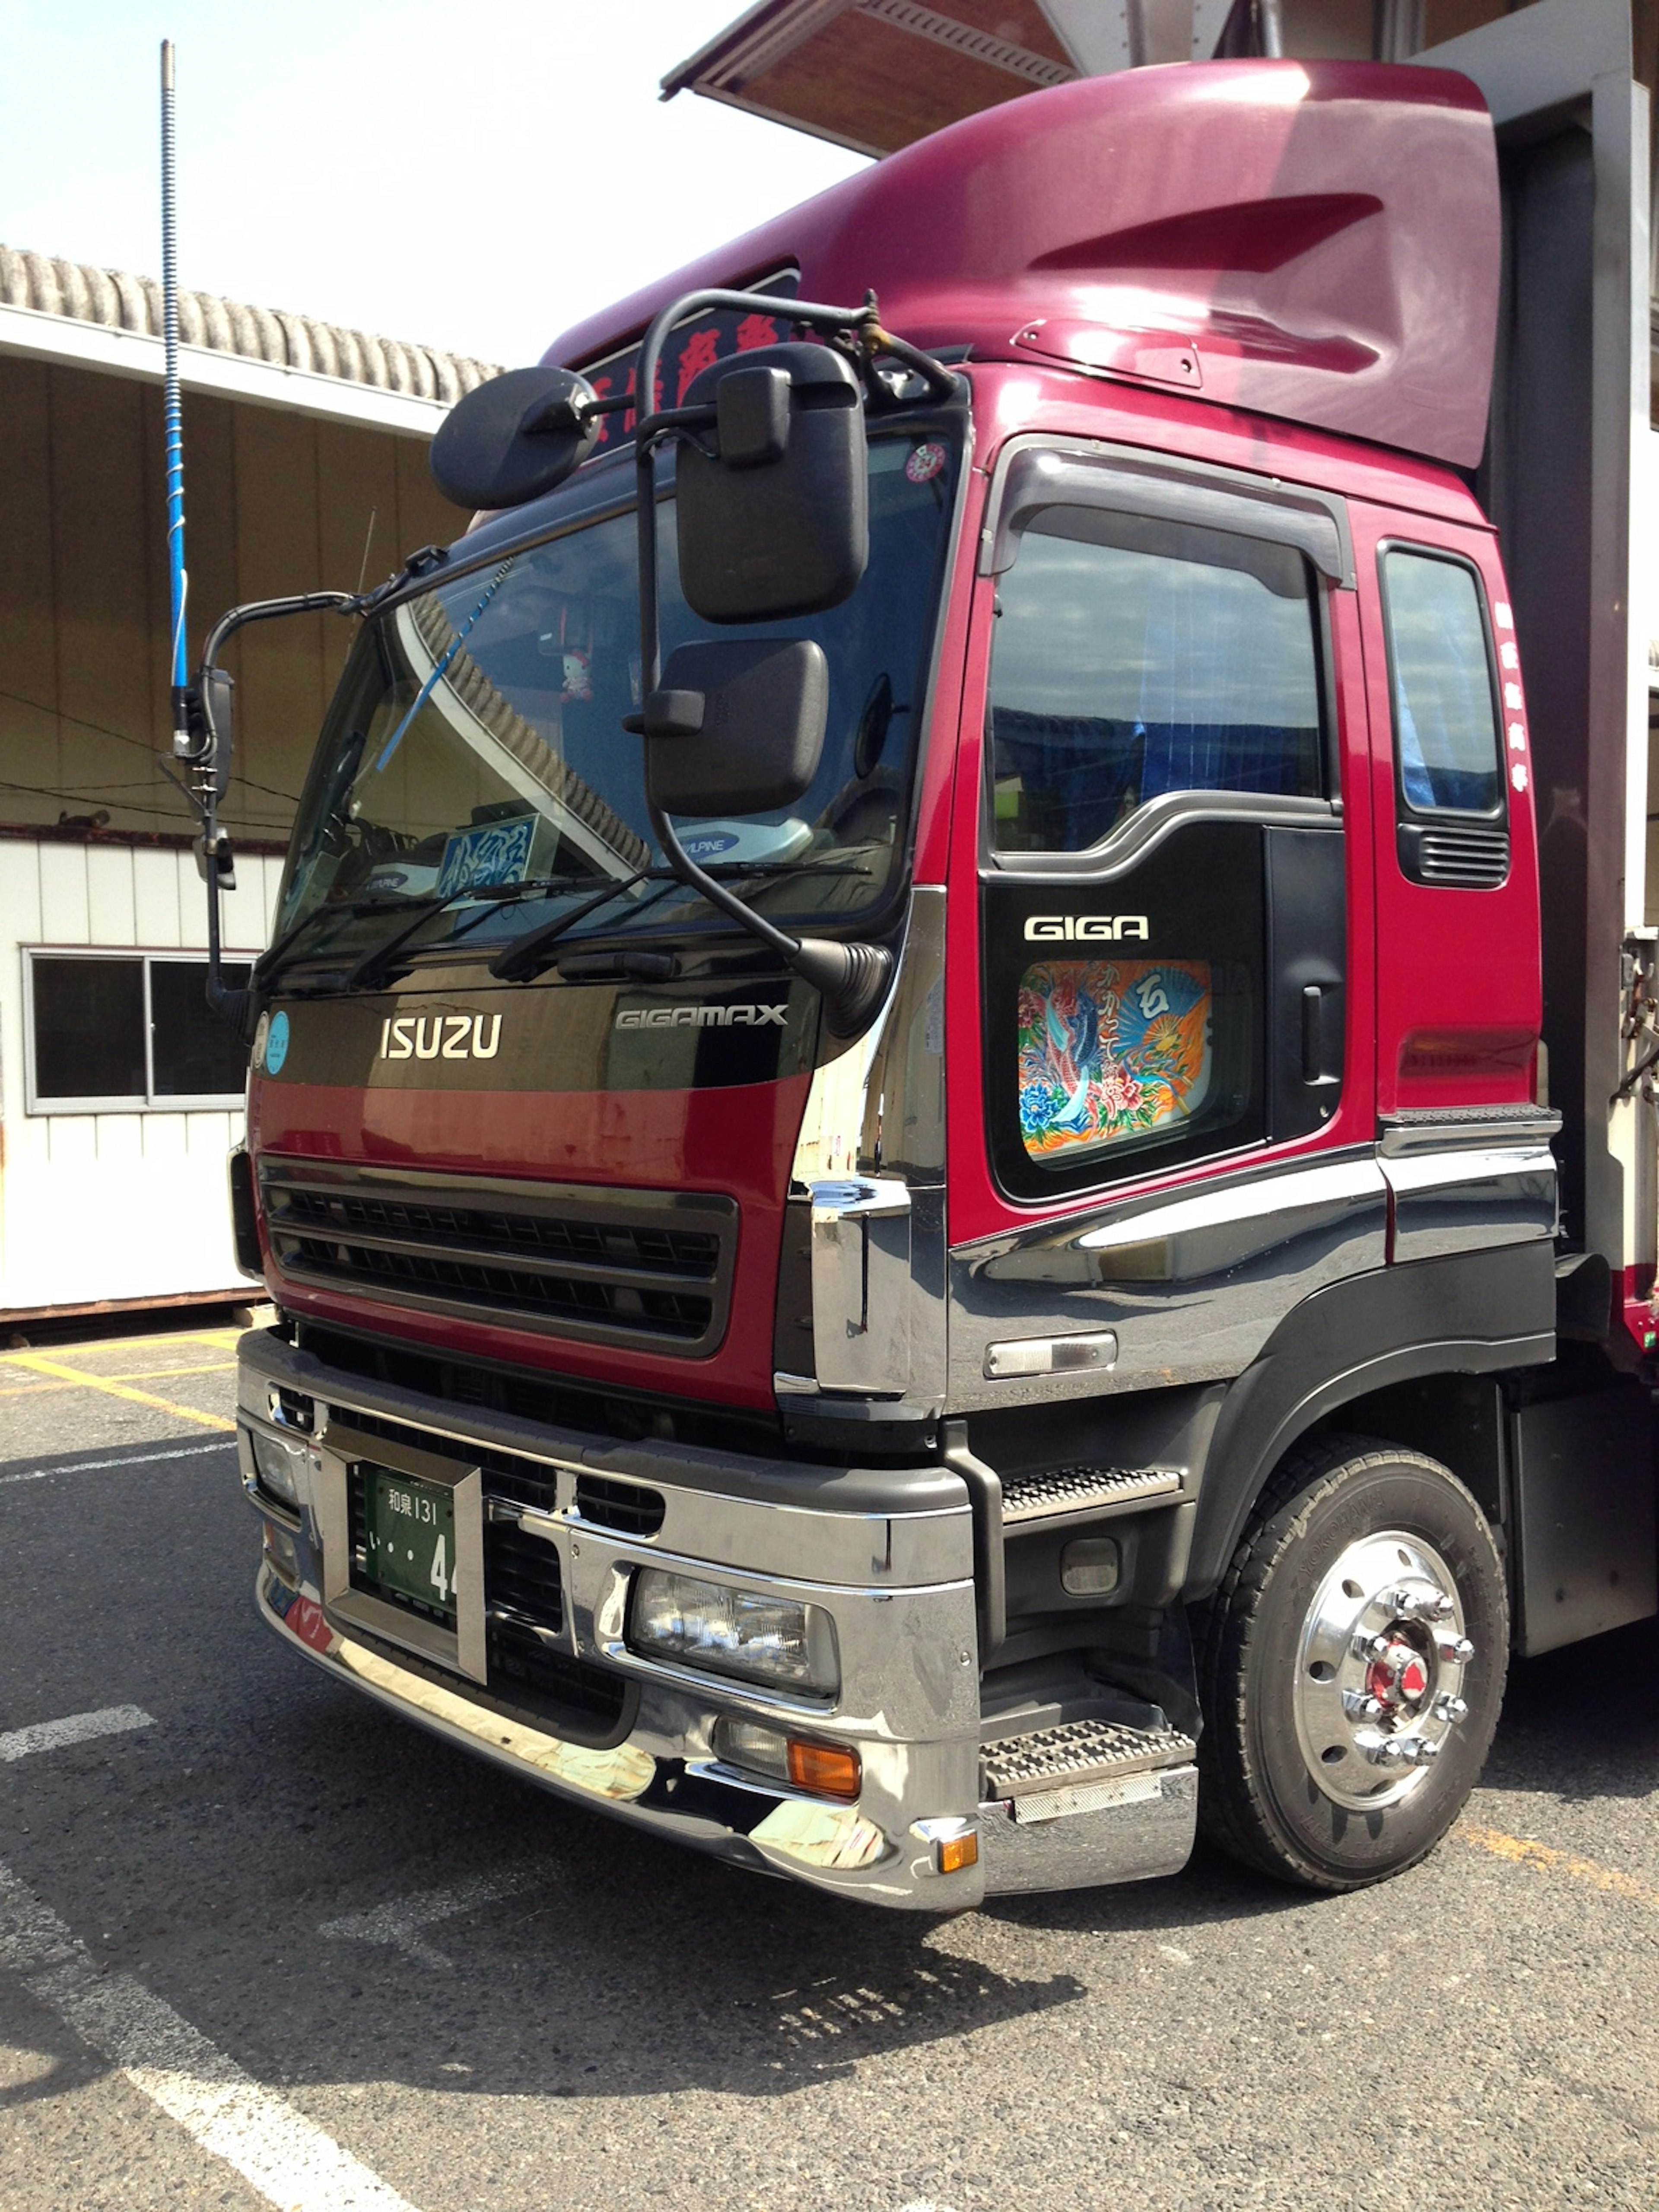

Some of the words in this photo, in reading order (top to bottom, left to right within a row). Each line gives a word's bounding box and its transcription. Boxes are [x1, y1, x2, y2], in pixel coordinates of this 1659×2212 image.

[1024, 915, 1150, 941] GIGA
[615, 1004, 789, 1030] GIGAMAX
[380, 1014, 502, 1059] ISUZU
[1299, 1490, 1387, 1576] YOKOHAMA
